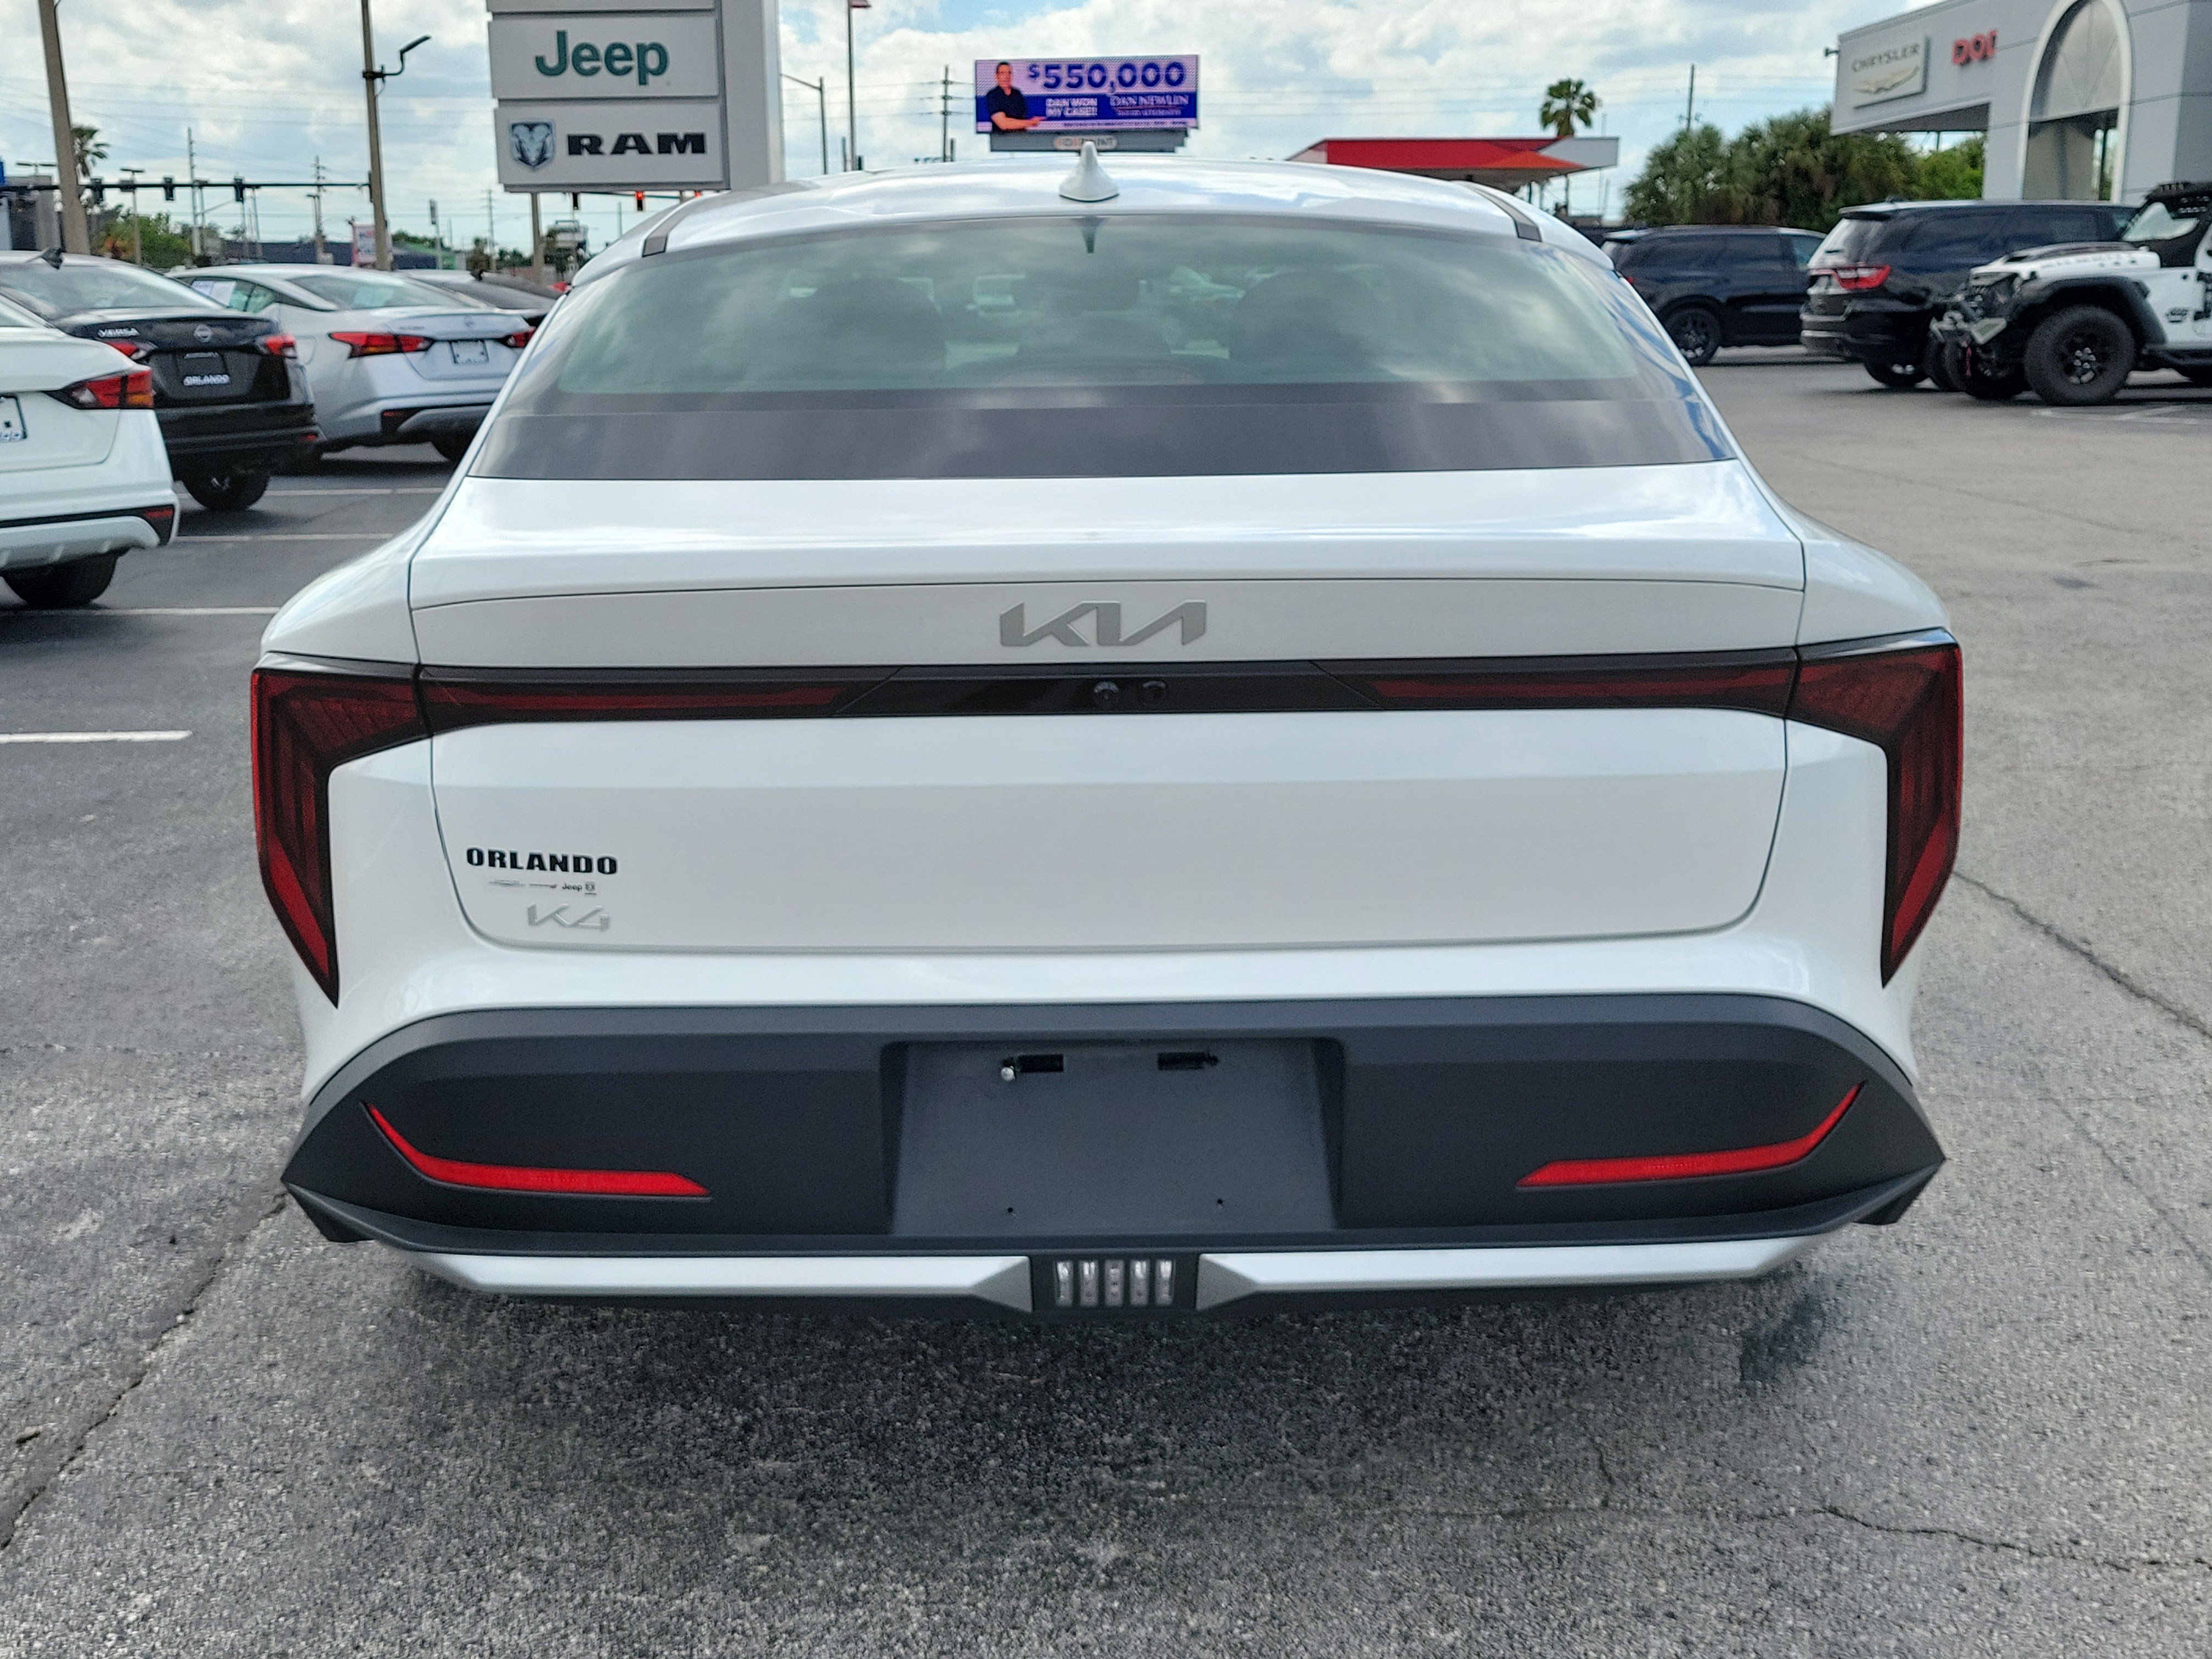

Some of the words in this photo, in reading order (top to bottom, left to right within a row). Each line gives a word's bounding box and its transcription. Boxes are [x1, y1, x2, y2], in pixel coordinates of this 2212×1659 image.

[535, 30, 669, 86] Jeep
[1028, 62, 1185, 93] $550,000
[567, 132, 706, 155] RAM
[183, 374, 231, 386] ORLANDO
[1000, 600, 1207, 646] KIA
[466, 848, 618, 875] ORLANDO
[562, 883, 583, 891] Jeep
[527, 902, 610, 932] K4
